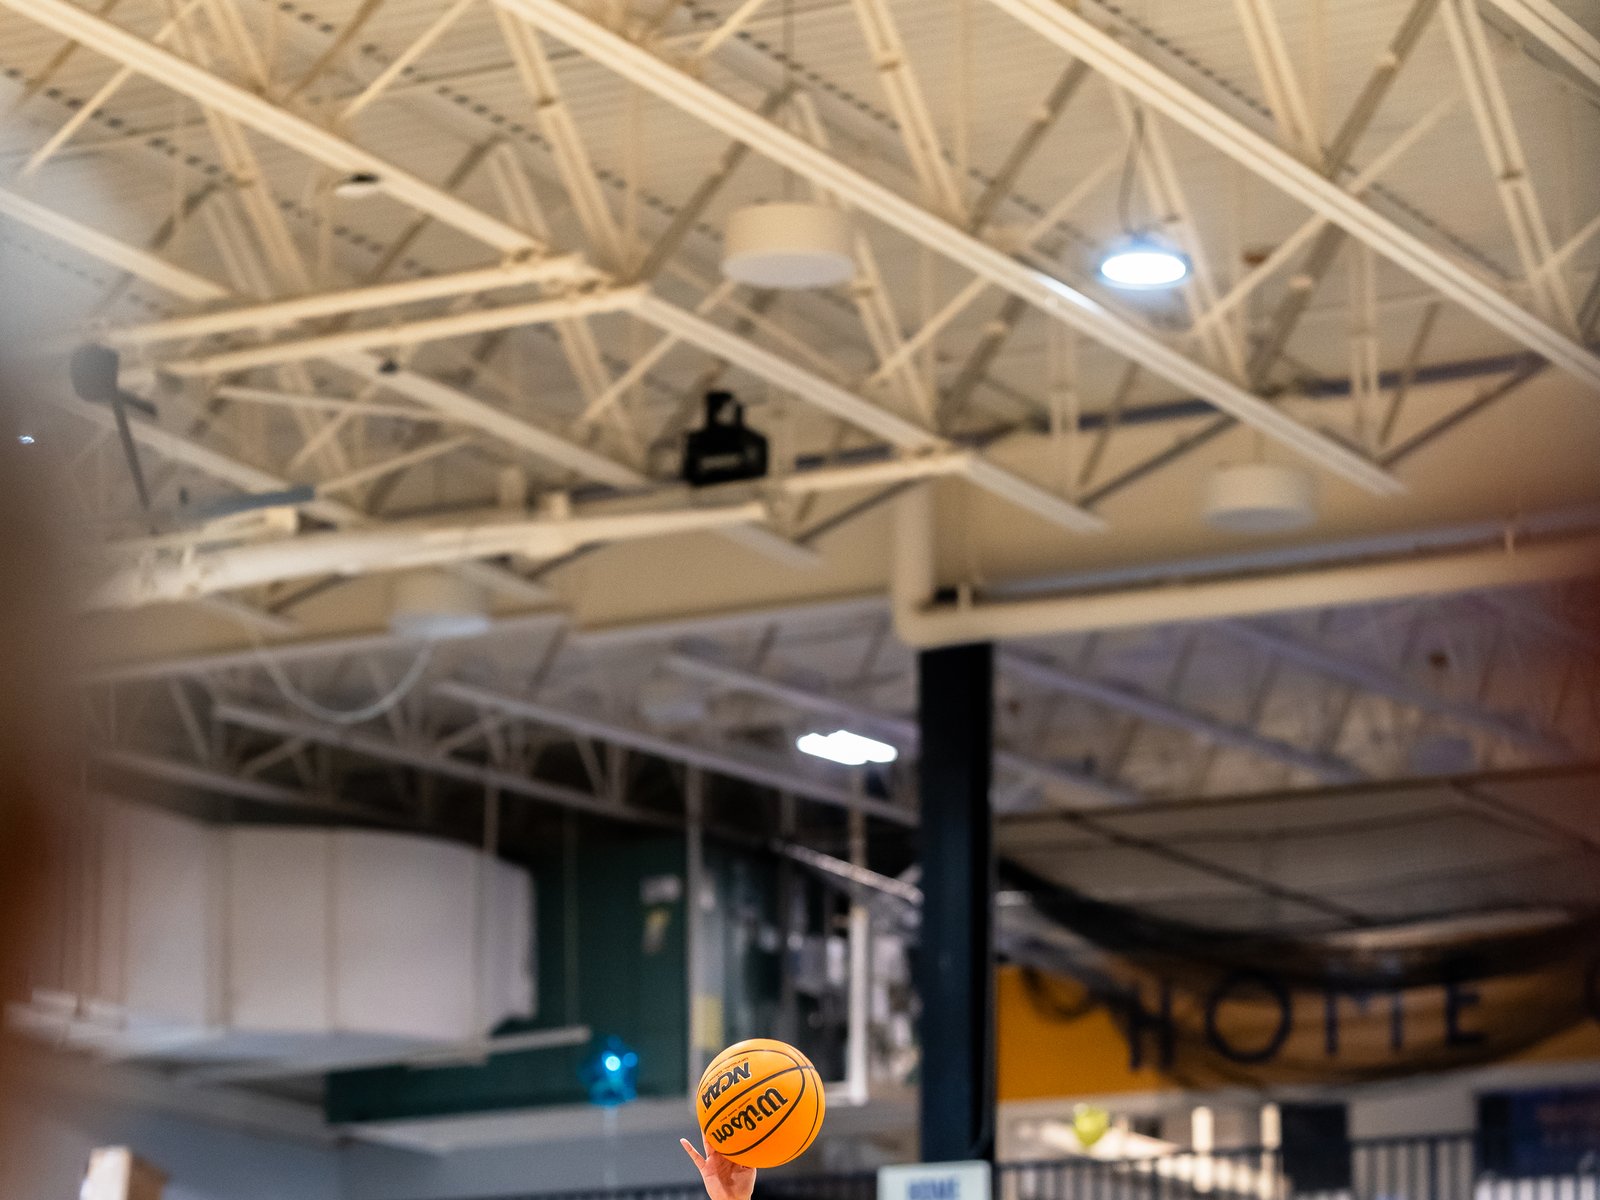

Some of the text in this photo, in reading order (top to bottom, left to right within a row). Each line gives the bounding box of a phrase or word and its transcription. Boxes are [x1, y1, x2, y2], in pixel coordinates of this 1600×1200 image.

[1122, 972, 1485, 1072] HOME
[702, 1062, 751, 1110] NCAA
[711, 1087, 788, 1144] Wilson
